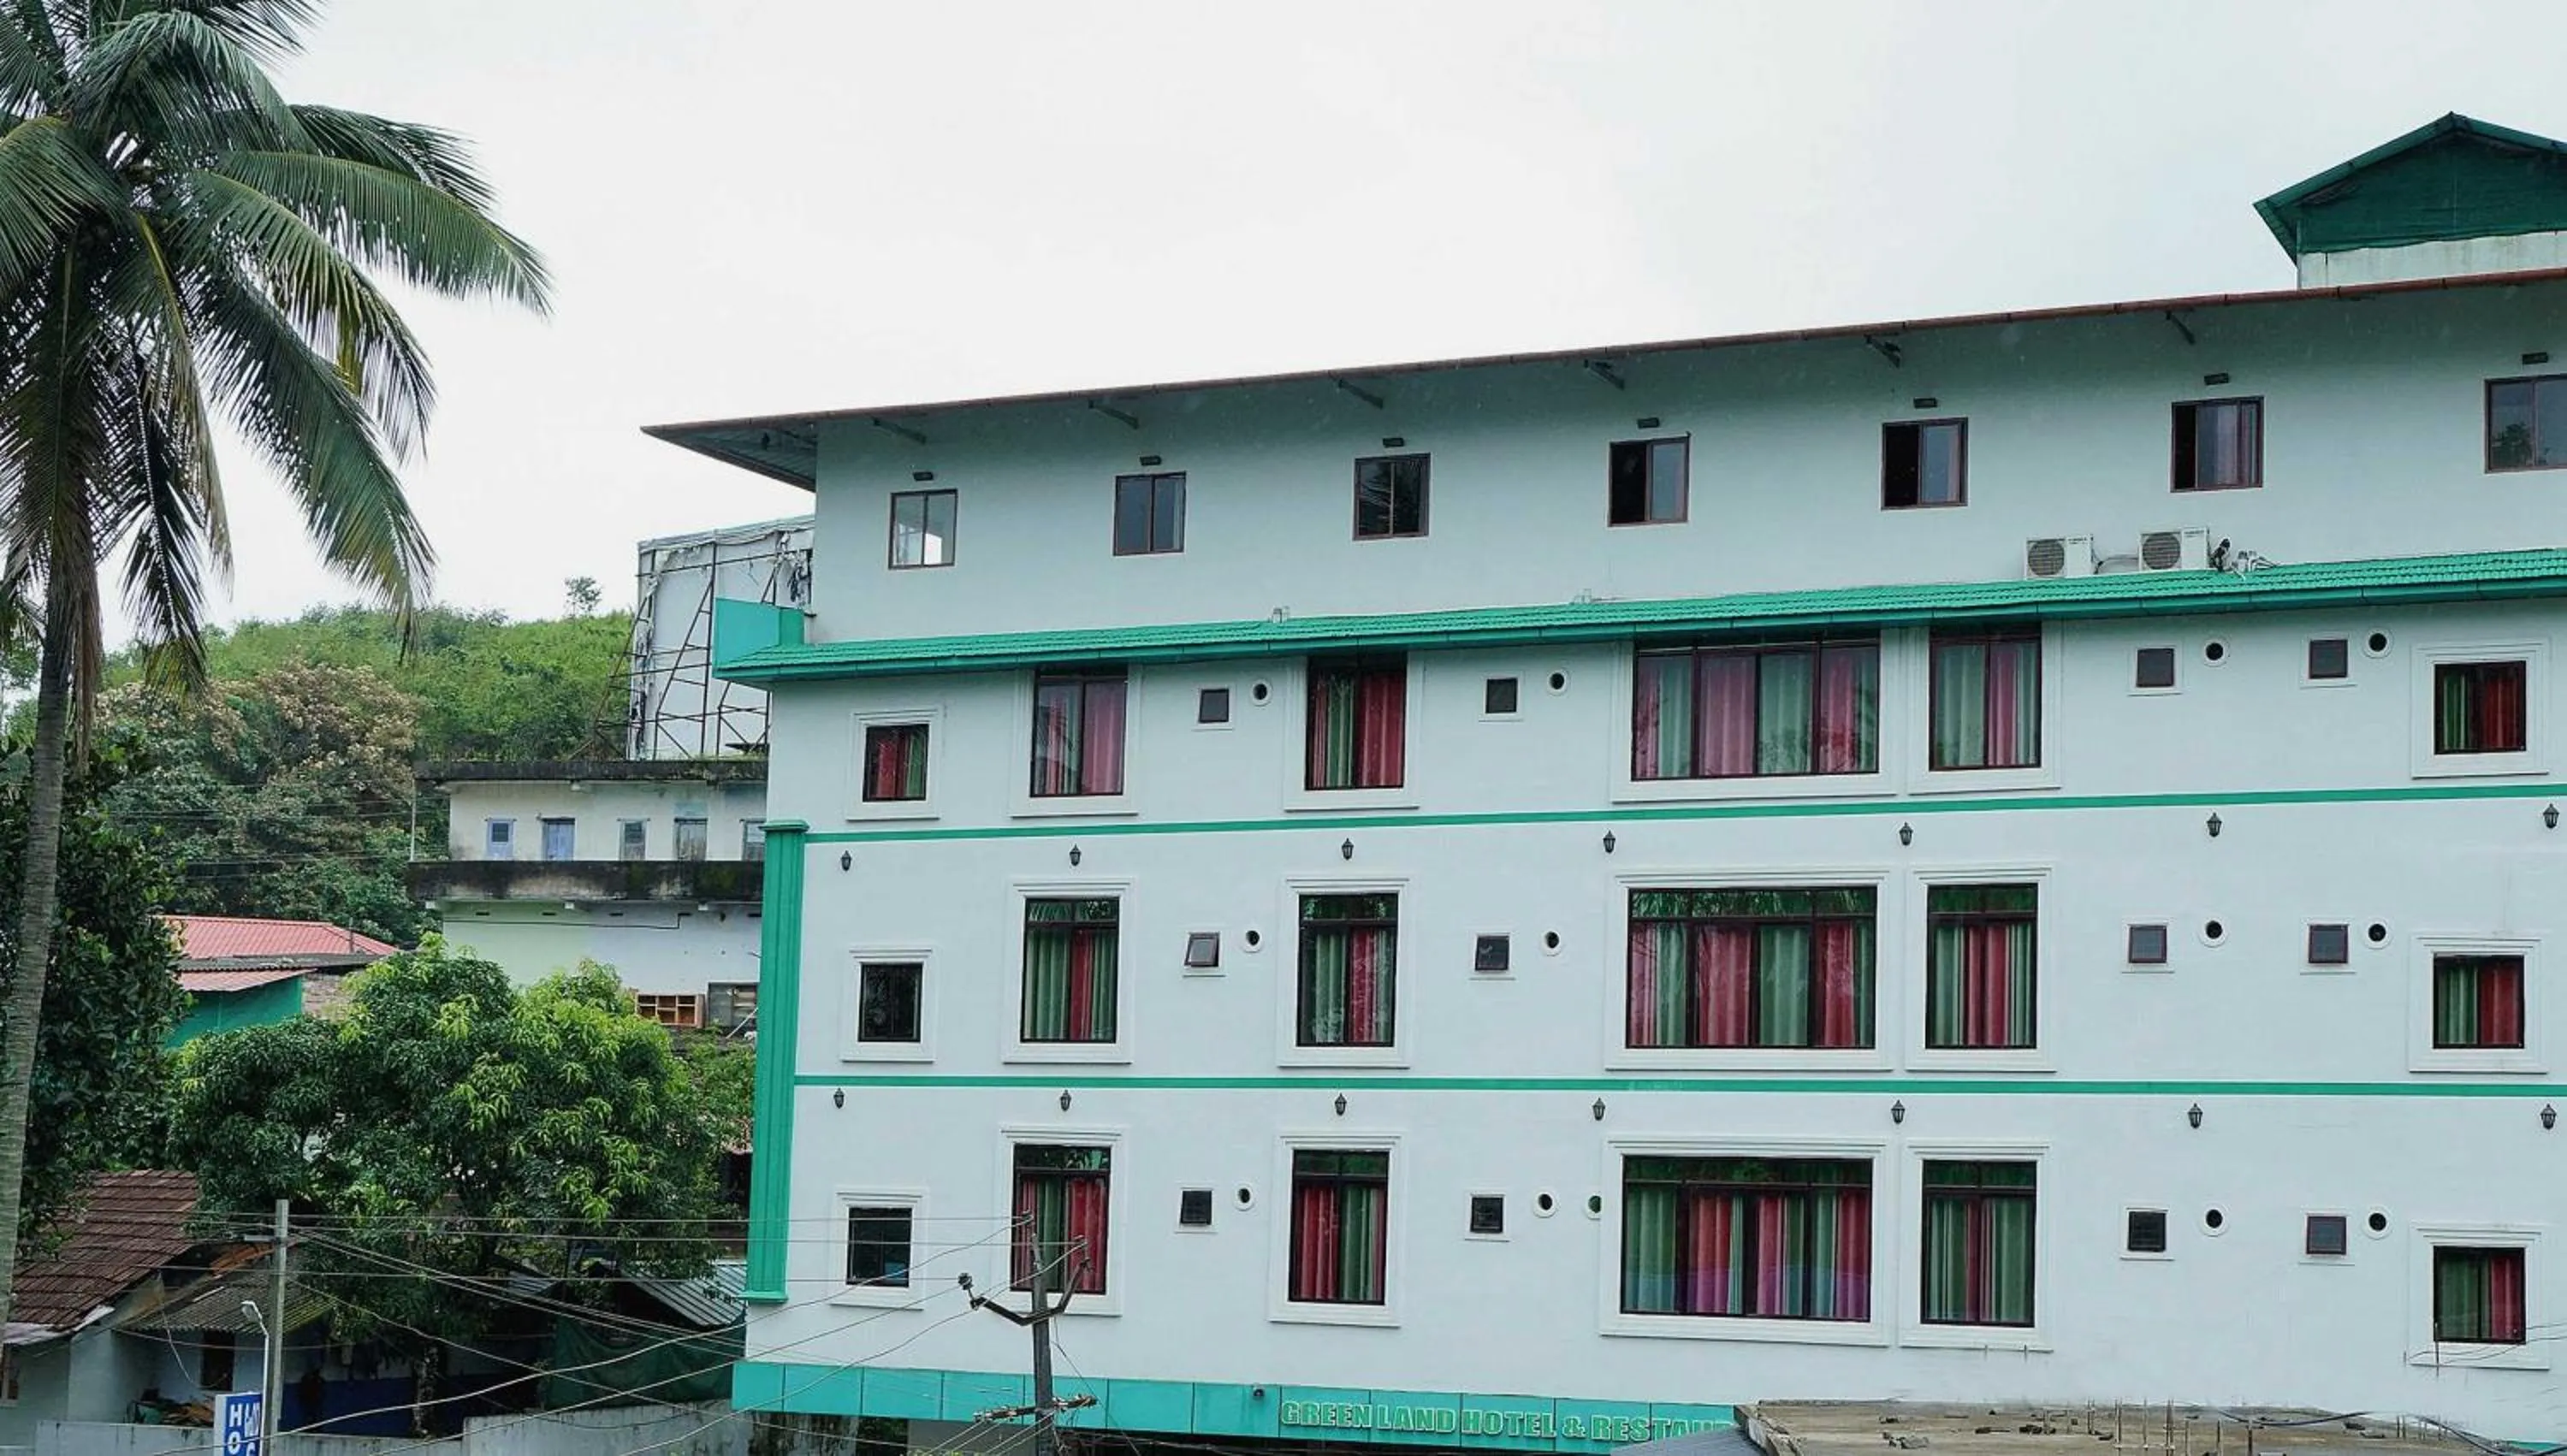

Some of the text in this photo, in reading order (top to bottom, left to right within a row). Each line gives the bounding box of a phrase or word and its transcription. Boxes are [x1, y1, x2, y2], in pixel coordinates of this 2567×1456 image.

[1282, 1401, 1372, 1427] GREEN
[1377, 1406, 1455, 1432] LAND
[1461, 1411, 1556, 1437] HOTEL
[1562, 1413, 1586, 1438] &
